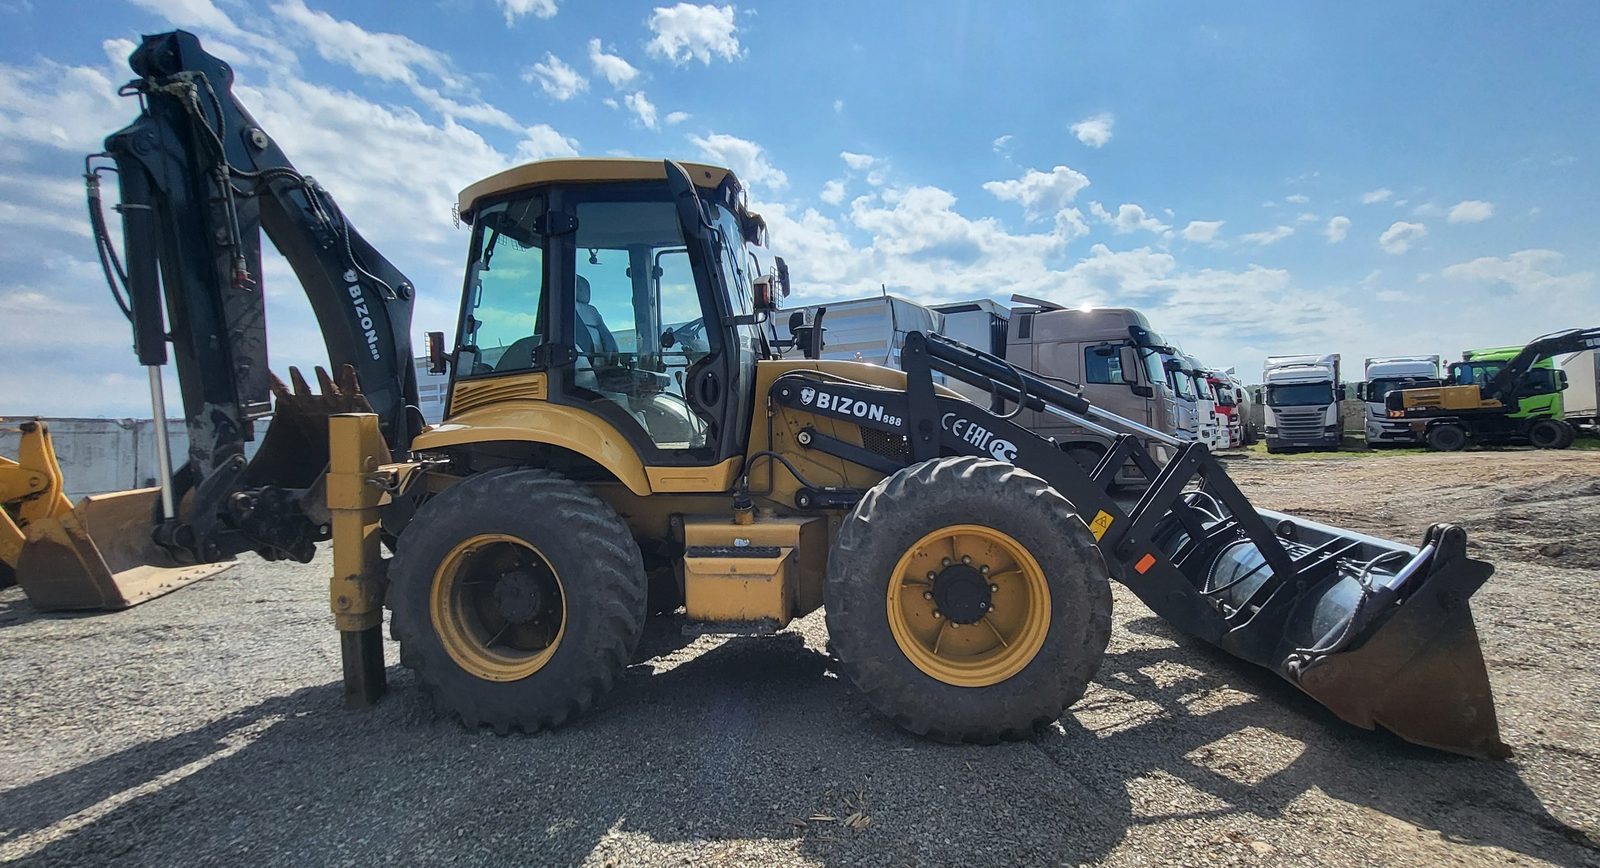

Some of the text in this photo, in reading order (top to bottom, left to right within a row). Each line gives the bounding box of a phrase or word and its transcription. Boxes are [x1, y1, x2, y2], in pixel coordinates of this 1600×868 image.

[348, 285, 378, 344] BIZON
[816, 392, 884, 422] BIZON
[941, 412, 968, 437] CE
